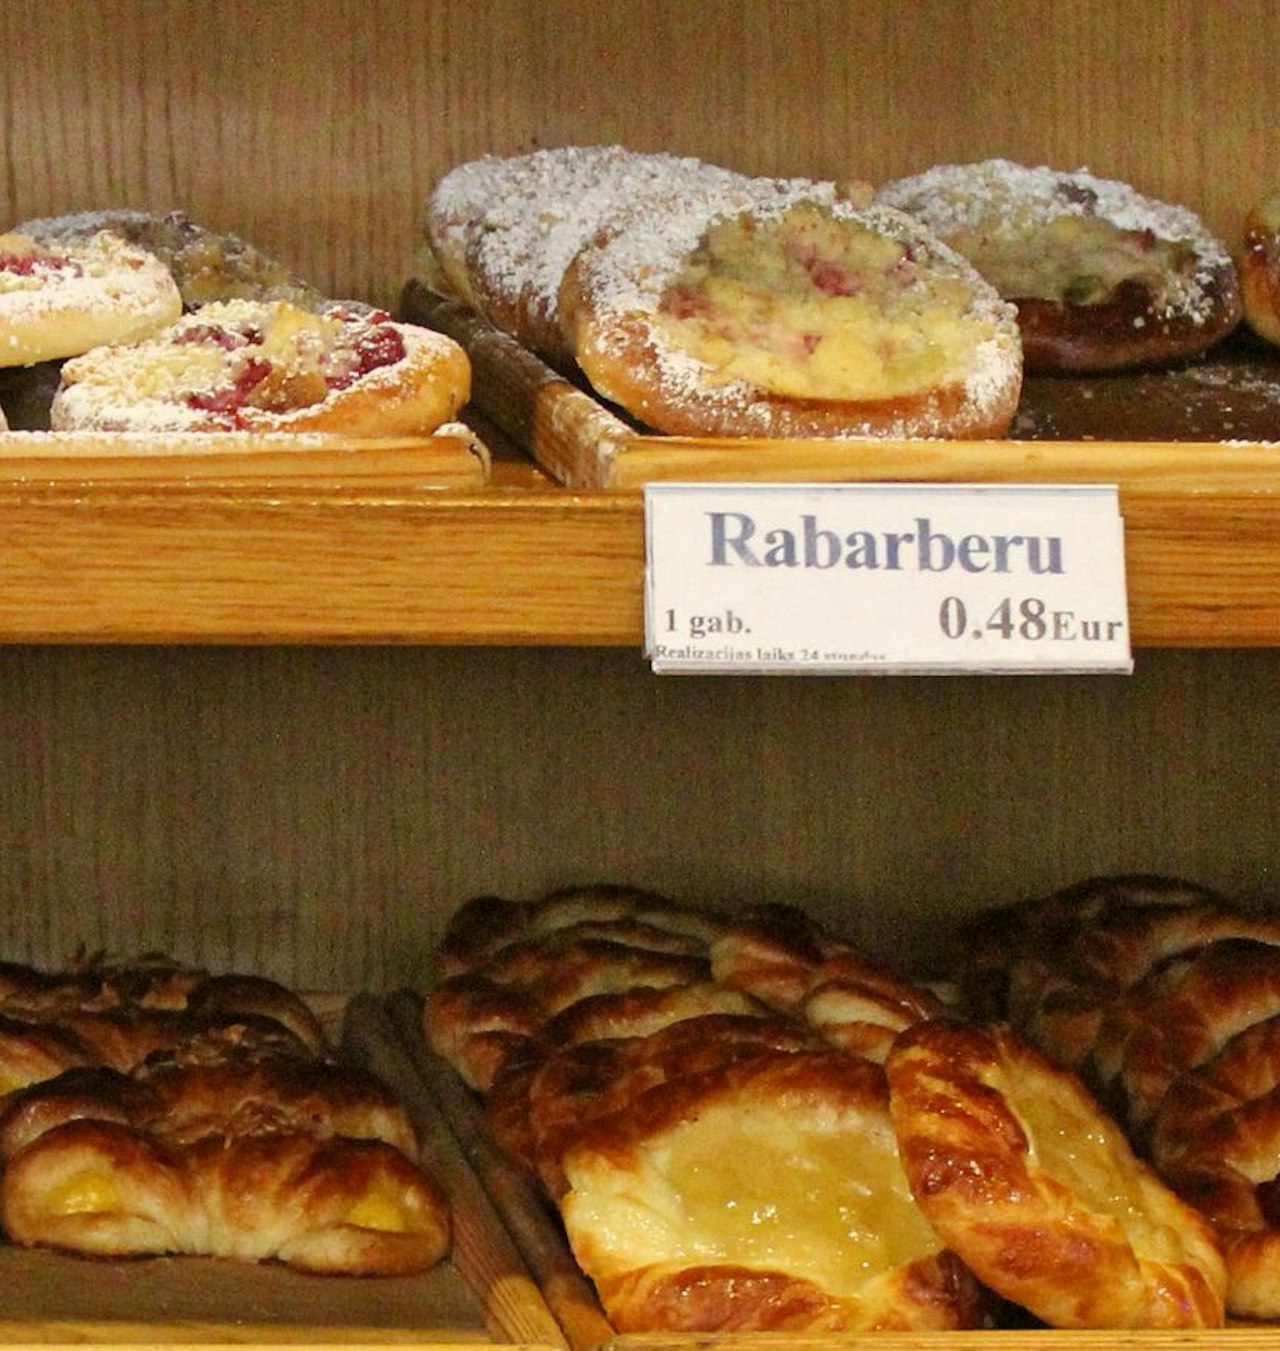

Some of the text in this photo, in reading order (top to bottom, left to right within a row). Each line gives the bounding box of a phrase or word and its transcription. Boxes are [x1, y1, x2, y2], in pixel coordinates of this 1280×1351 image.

[704, 512, 1065, 575] Rabarberu
[665, 609, 752, 638] 1 gab.
